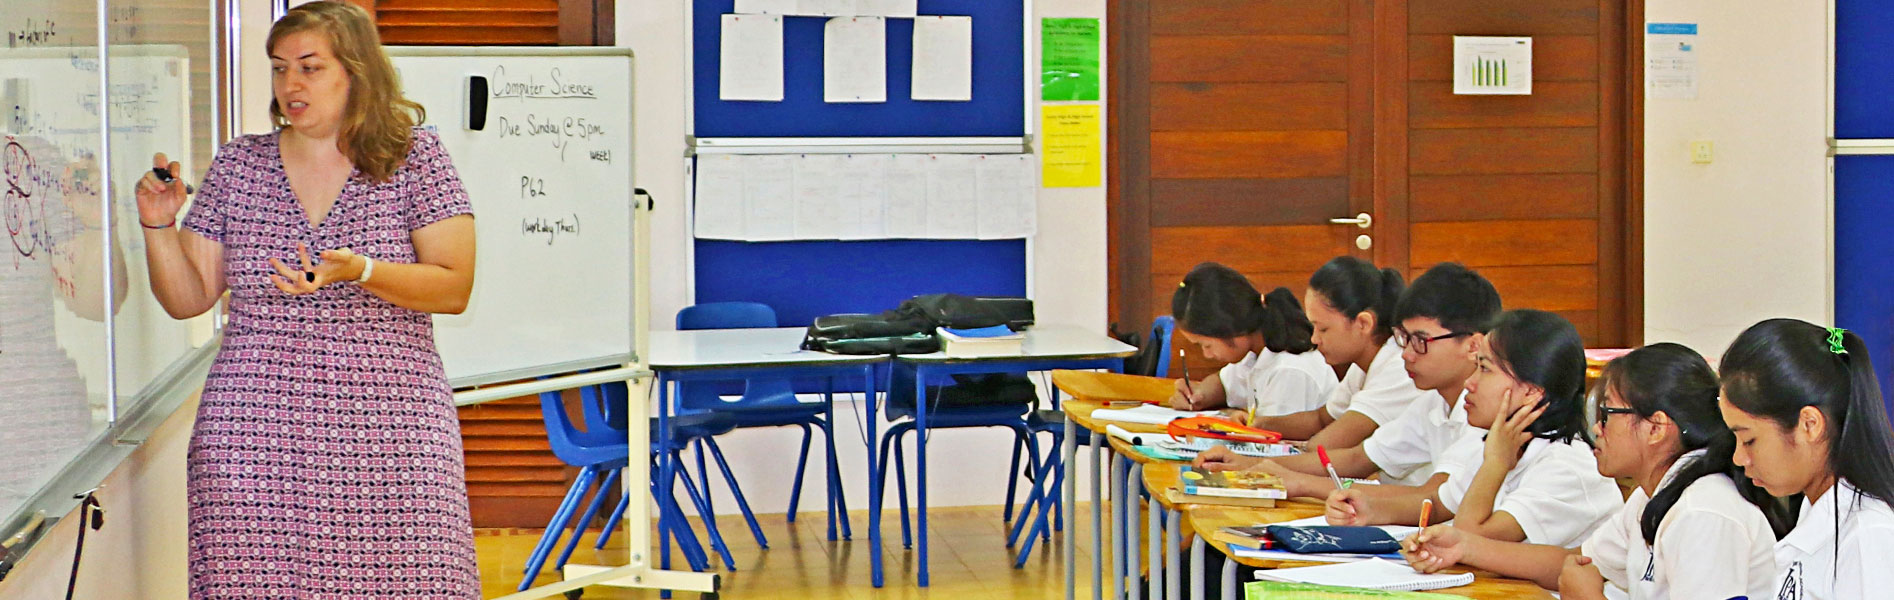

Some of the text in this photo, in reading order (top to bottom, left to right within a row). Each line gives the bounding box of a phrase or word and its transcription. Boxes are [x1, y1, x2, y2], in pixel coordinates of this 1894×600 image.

[492, 65, 594, 101] Computer Science
[499, 116, 521, 138] Due
[527, 113, 560, 149] Sunday
[563, 116, 574, 137] @
[521, 176, 546, 198] P62
